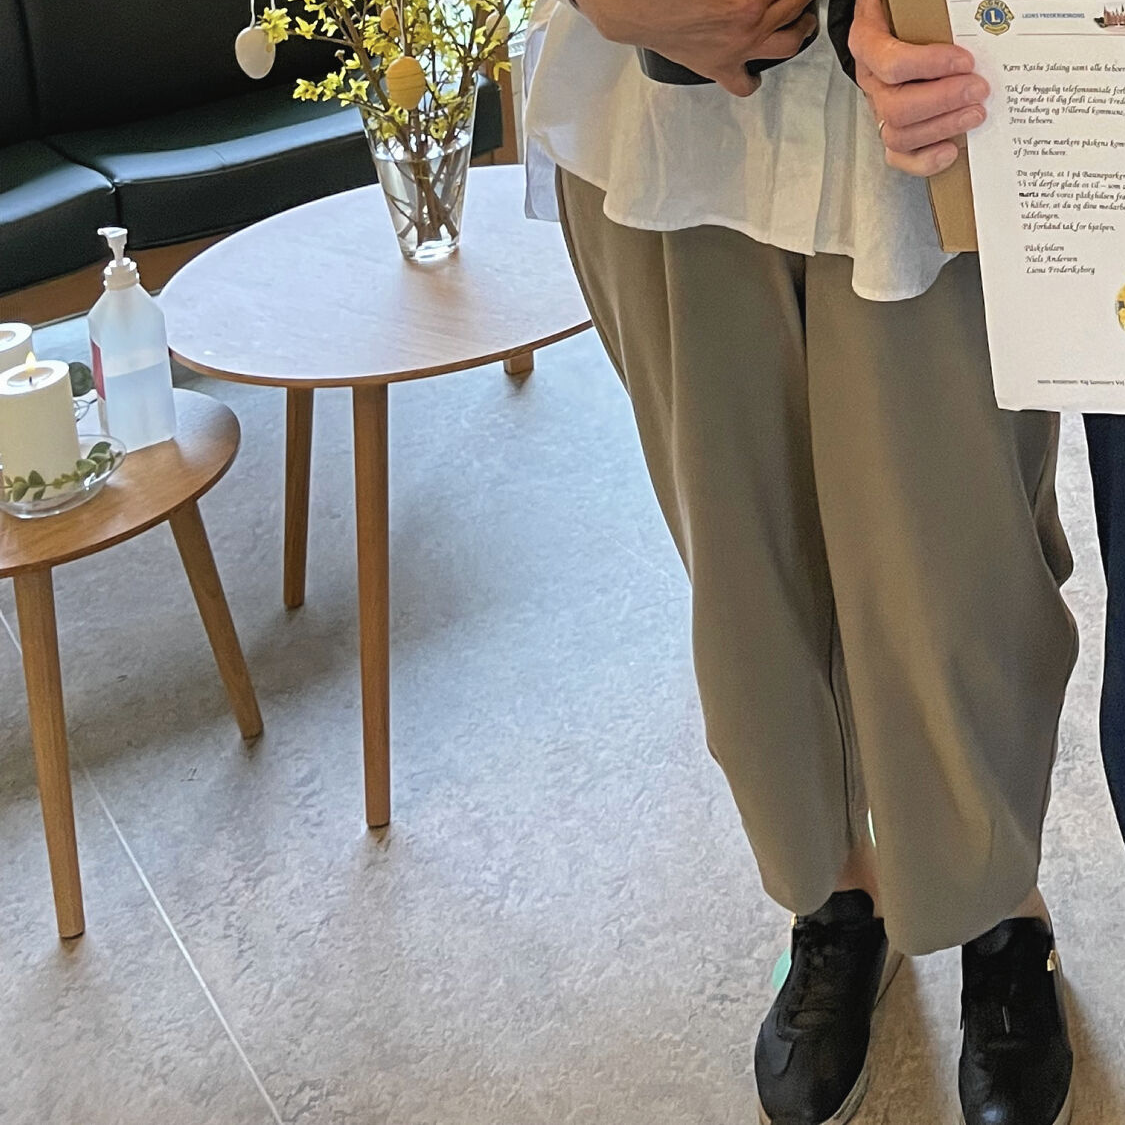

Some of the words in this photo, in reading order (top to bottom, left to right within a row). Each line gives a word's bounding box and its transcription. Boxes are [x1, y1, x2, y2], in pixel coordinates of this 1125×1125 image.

[989, 10, 1001, 23] L
[1089, 63, 1103, 72] alle
[1005, 84, 1020, 95] Tak
[1019, 83, 1031, 95] for
[1032, 84, 1061, 95] hyggelig
[1006, 95, 1019, 105] Jeg
[1020, 95, 1045, 105] ringede
[1046, 95, 1055, 103] til
[1056, 95, 1067, 105] dig
[1068, 95, 1085, 105] fordi
[1087, 96, 1107, 104] Lions
[1008, 105, 1050, 116] Fredensborg
[1051, 108, 1060, 116] og
[1009, 116, 1026, 125] Jeres
[1012, 137, 1022, 145] Vi
[1023, 137, 1033, 145] vil
[1033, 139, 1052, 148] gerne
[1053, 137, 1080, 148] markere
[1081, 138, 1109, 148] påskens
[1013, 147, 1023, 158] af
[1022, 148, 1039, 157] Jeres
[1016, 169, 1028, 177] Du
[1071, 171, 1081, 180] på
[1017, 180, 1027, 188] Vi
[1027, 179, 1038, 187] vil
[1038, 180, 1060, 190] derfor
[1090, 180, 1101, 189] til
[1040, 190, 1056, 198] med
[1061, 201, 1072, 209] du
[1072, 203, 1081, 211] og
[1082, 201, 1098, 210] dine
[1022, 222, 1032, 230] På
[1032, 221, 1061, 233] forhånd
[1062, 222, 1075, 231] tak
[1073, 221, 1087, 232] for
[1023, 243, 1065, 253] Påskehilsen
[1024, 254, 1044, 263] Niels
[1044, 254, 1078, 264] Andersen
[1026, 266, 1046, 274] Lions
[1048, 265, 1096, 276] Frederiksborg
